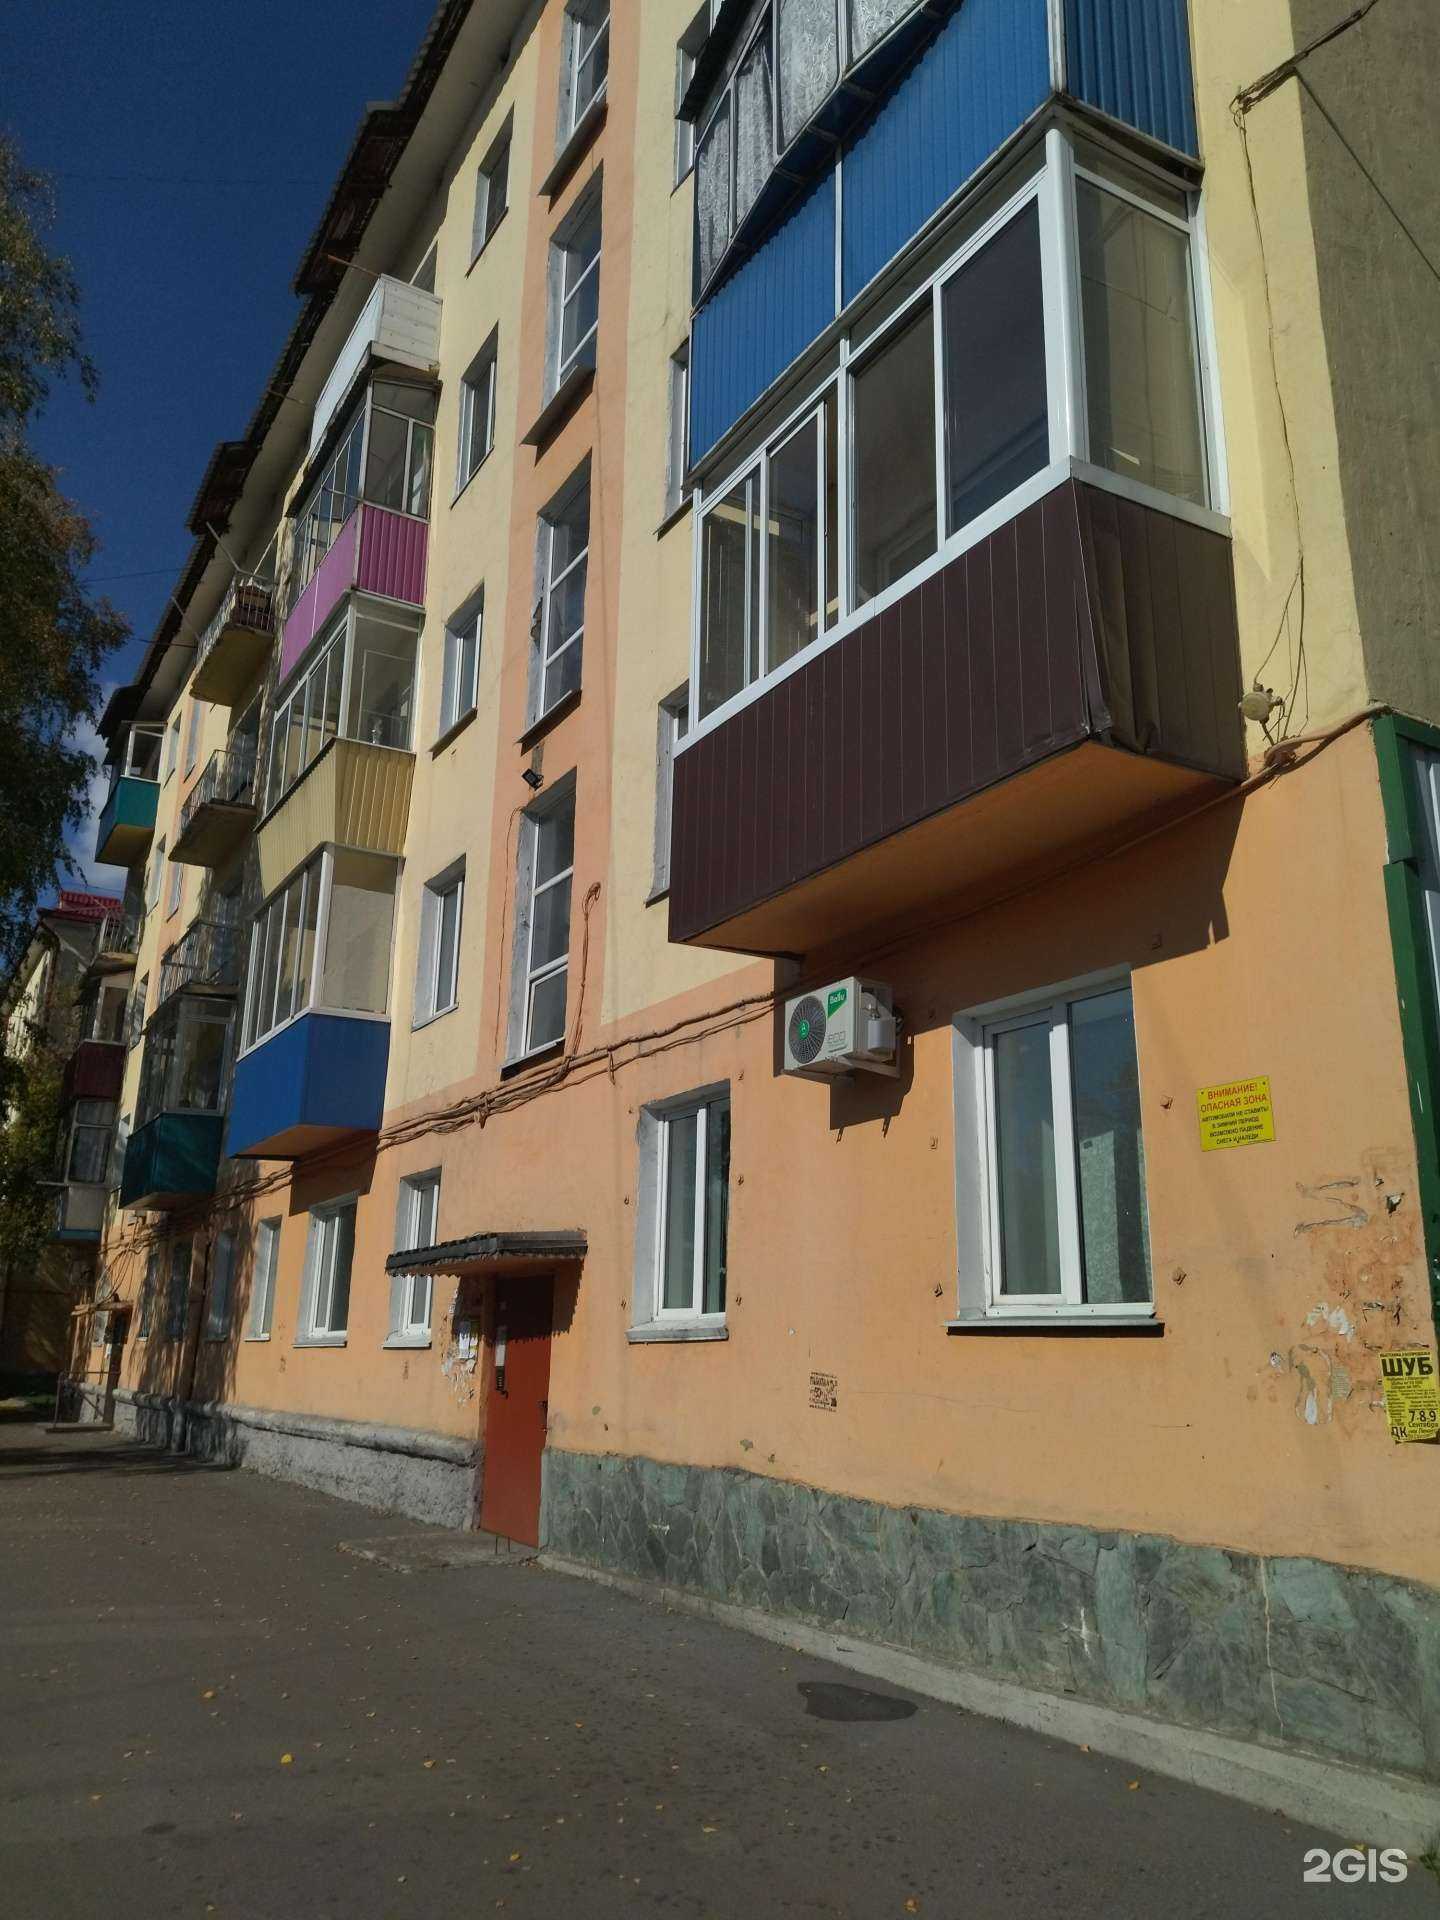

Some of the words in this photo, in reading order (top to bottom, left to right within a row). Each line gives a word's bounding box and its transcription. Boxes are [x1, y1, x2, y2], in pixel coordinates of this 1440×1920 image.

[1208, 1083, 1258, 1100] ВНИМАНИЕ!
[1200, 1098, 1241, 1112] ОПАСНАЯ
[1244, 1094, 1267, 1106] ЗОНА
[1210, 1127, 1239, 1137] ВОЗМОЖНО
[1239, 1124, 1264, 1133] ПАДЕНИЕ
[1381, 1356, 1434, 1377] ШУБ
[1391, 1426, 1408, 1440] ДК
